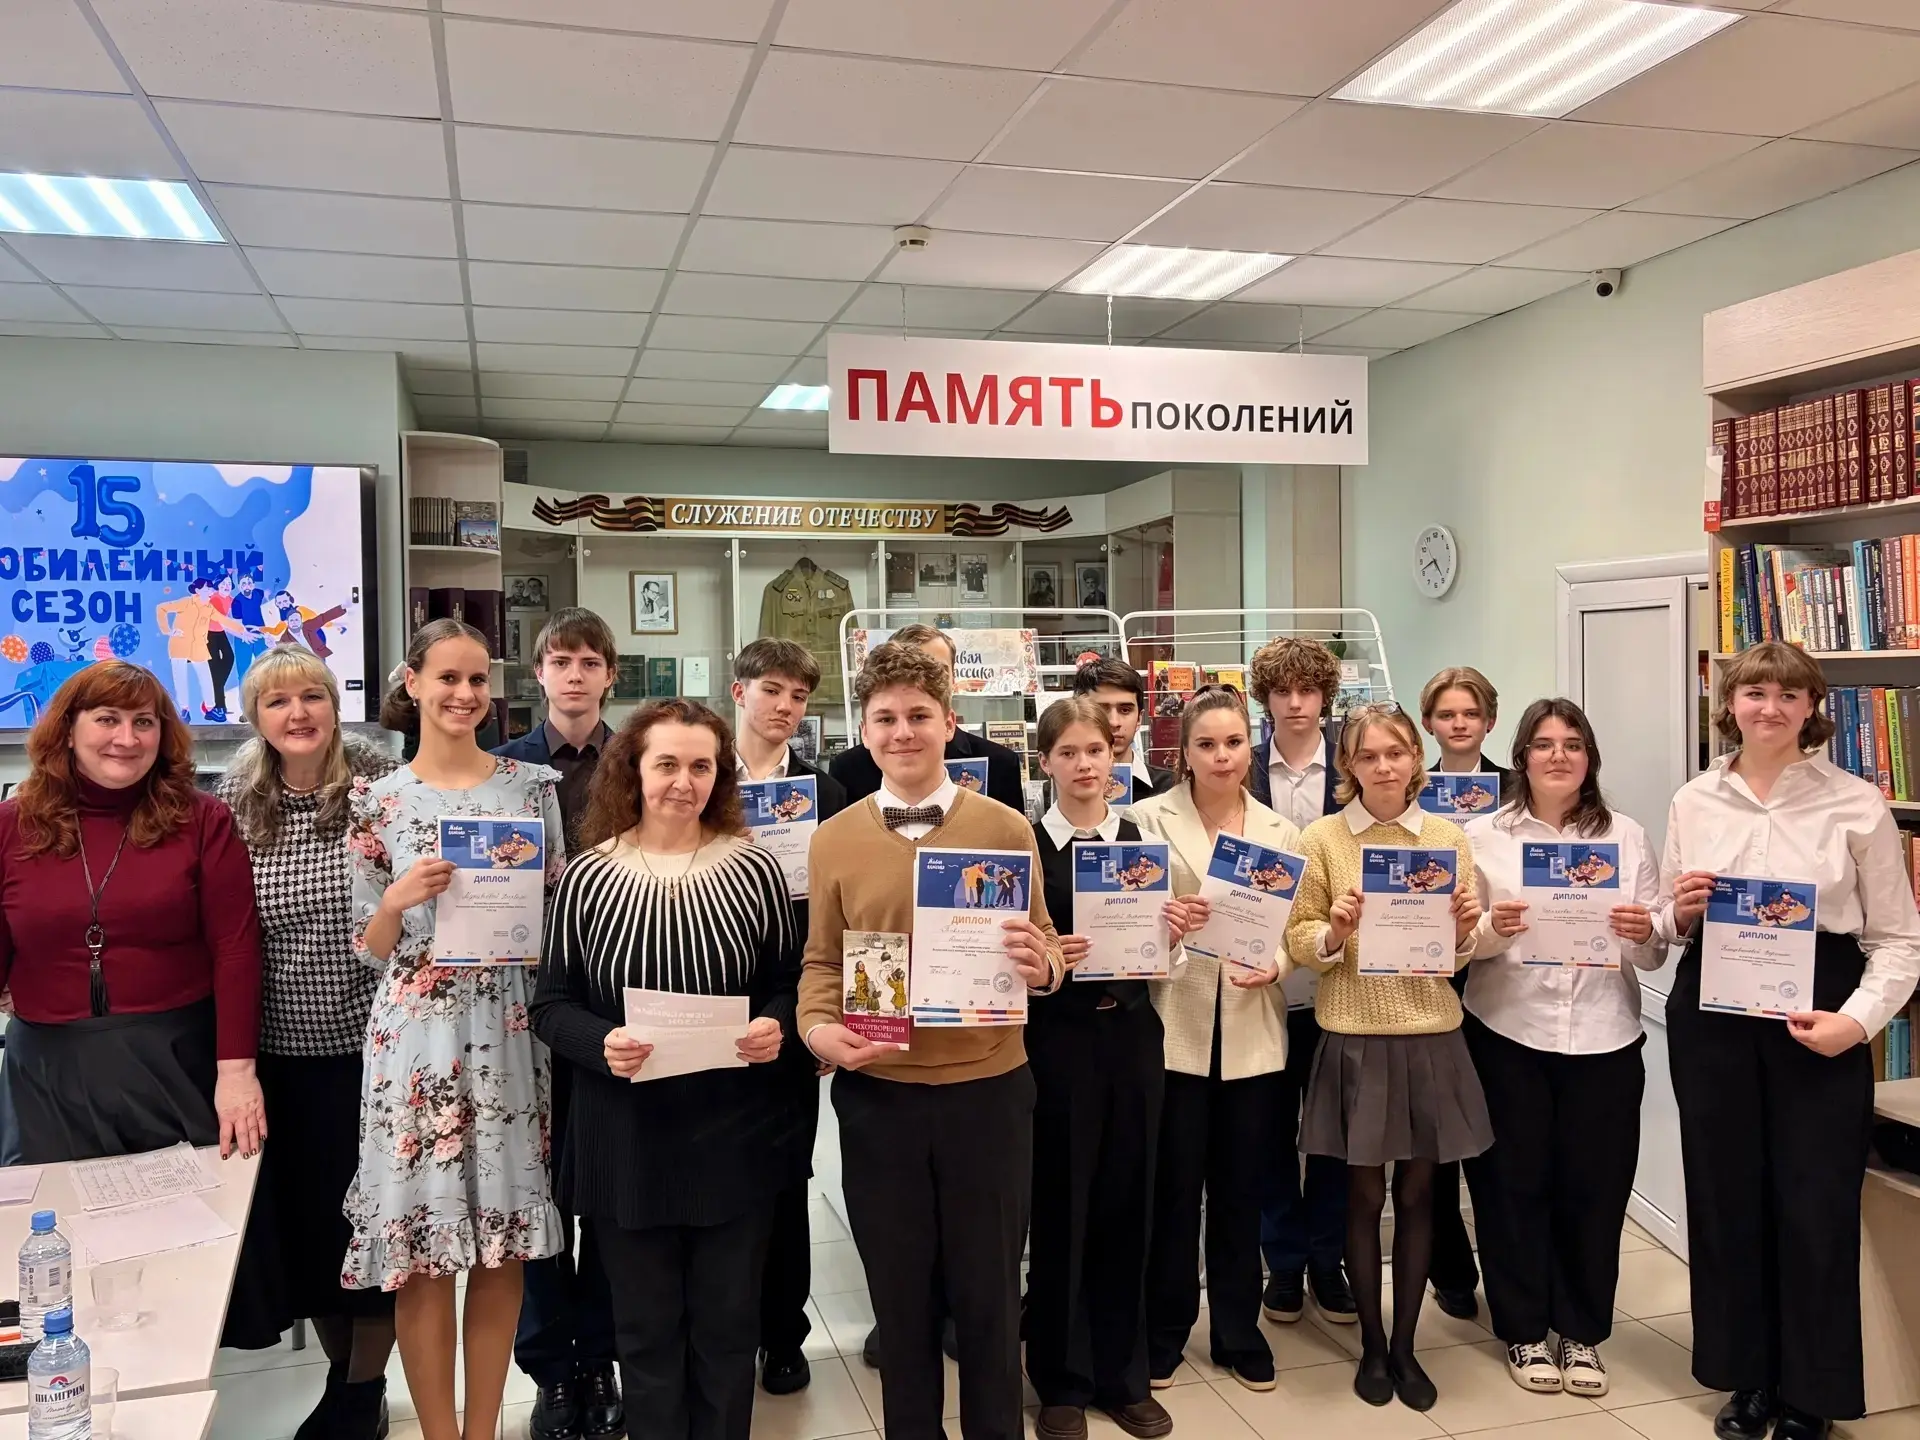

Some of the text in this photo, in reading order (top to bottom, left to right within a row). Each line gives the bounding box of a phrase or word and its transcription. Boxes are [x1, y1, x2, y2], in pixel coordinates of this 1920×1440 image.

[848, 368, 1354, 435] ПАМЯТЬ ПОКОЛЕНИЙ
[68, 464, 146, 548] 15
[671, 503, 938, 528] СЛУЖЕНИЕ ОТЕЧЕСТВУ
[12, 589, 142, 624] СЕЗОН
[1874, 577, 1883, 632] КОСМОНАВТИКА
[953, 667, 995, 679] ассика
[761, 828, 791, 838] ДИПЛОМ
[474, 875, 510, 884] ДИПЛОМ
[1105, 897, 1138, 906] ДИПЛОМ
[1230, 889, 1262, 903] ДИПЛОМ
[1391, 898, 1425, 906] ДИПЛОМ
[951, 915, 992, 925] ДИПЛОМ
[1739, 930, 1778, 941] ДИПЛОМ
[847, 1023, 905, 1033] СТИХОТВОРЕНИЯ
[866, 1031, 892, 1039] ПОЭМЫ
[35, 1384, 85, 1402] ПИЛИГРИМ
